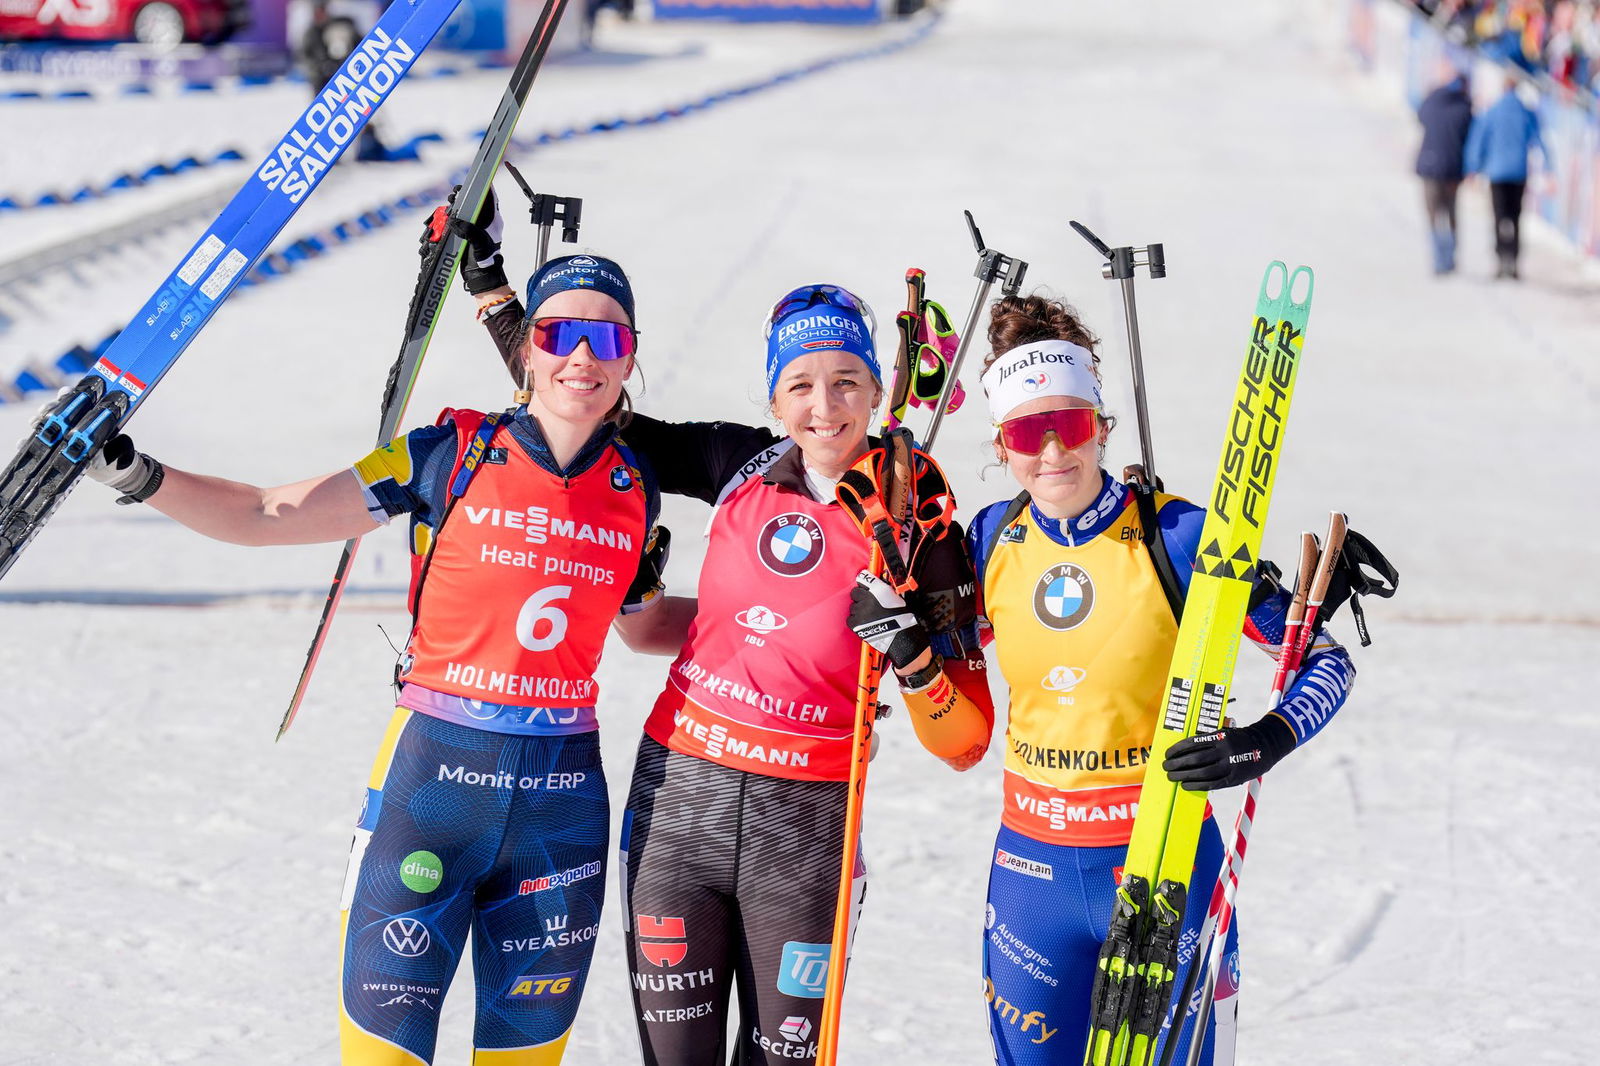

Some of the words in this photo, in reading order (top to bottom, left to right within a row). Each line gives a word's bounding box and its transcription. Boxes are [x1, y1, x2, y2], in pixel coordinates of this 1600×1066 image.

[258, 27, 392, 191] SALOMON
[280, 38, 416, 204] SALOMON
[420, 250, 458, 329] ROSSIGNOL
[540, 267, 598, 288] Monitor
[600, 269, 624, 288] ERP
[778, 315, 862, 343] ERDINGER
[779, 329, 863, 352] ALKOHOLFREI
[999, 350, 1075, 387] JuraFlore
[1214, 316, 1276, 525] FISCHER
[1242, 320, 1301, 529] FISCHER
[465, 435, 487, 472] ATG
[464, 505, 633, 552] VIESSMANN
[777, 516, 822, 541] BMW
[480, 544, 538, 569] Heat
[543, 556, 615, 586] pumps
[1042, 566, 1089, 585] BMW
[515, 585, 573, 652] 6
[744, 634, 765, 648] IBU
[444, 662, 595, 700] HOLMENKOLLEN
[679, 659, 828, 723] HOLMENKOLLEN
[929, 688, 958, 721] WÜRT
[1058, 696, 1075, 705] IBU
[673, 709, 810, 767] VIESSMANN
[546, 772, 586, 790] ERP
[404, 860, 439, 880] dina
[518, 860, 601, 896] Autoexperten
[1006, 856, 1028, 869] Jean
[1029, 861, 1051, 875] Lain
[502, 922, 599, 952] SVEASKOG
[996, 923, 1053, 968] Auvergne-
[991, 932, 1059, 988] Rhône-Alpes
[362, 982, 440, 995] SWEDEMOUNT
[510, 977, 573, 996] ATG
[655, 1001, 713, 1023] TERREX
[985, 975, 1058, 1044] omfy
[752, 1026, 819, 1059] tectak
